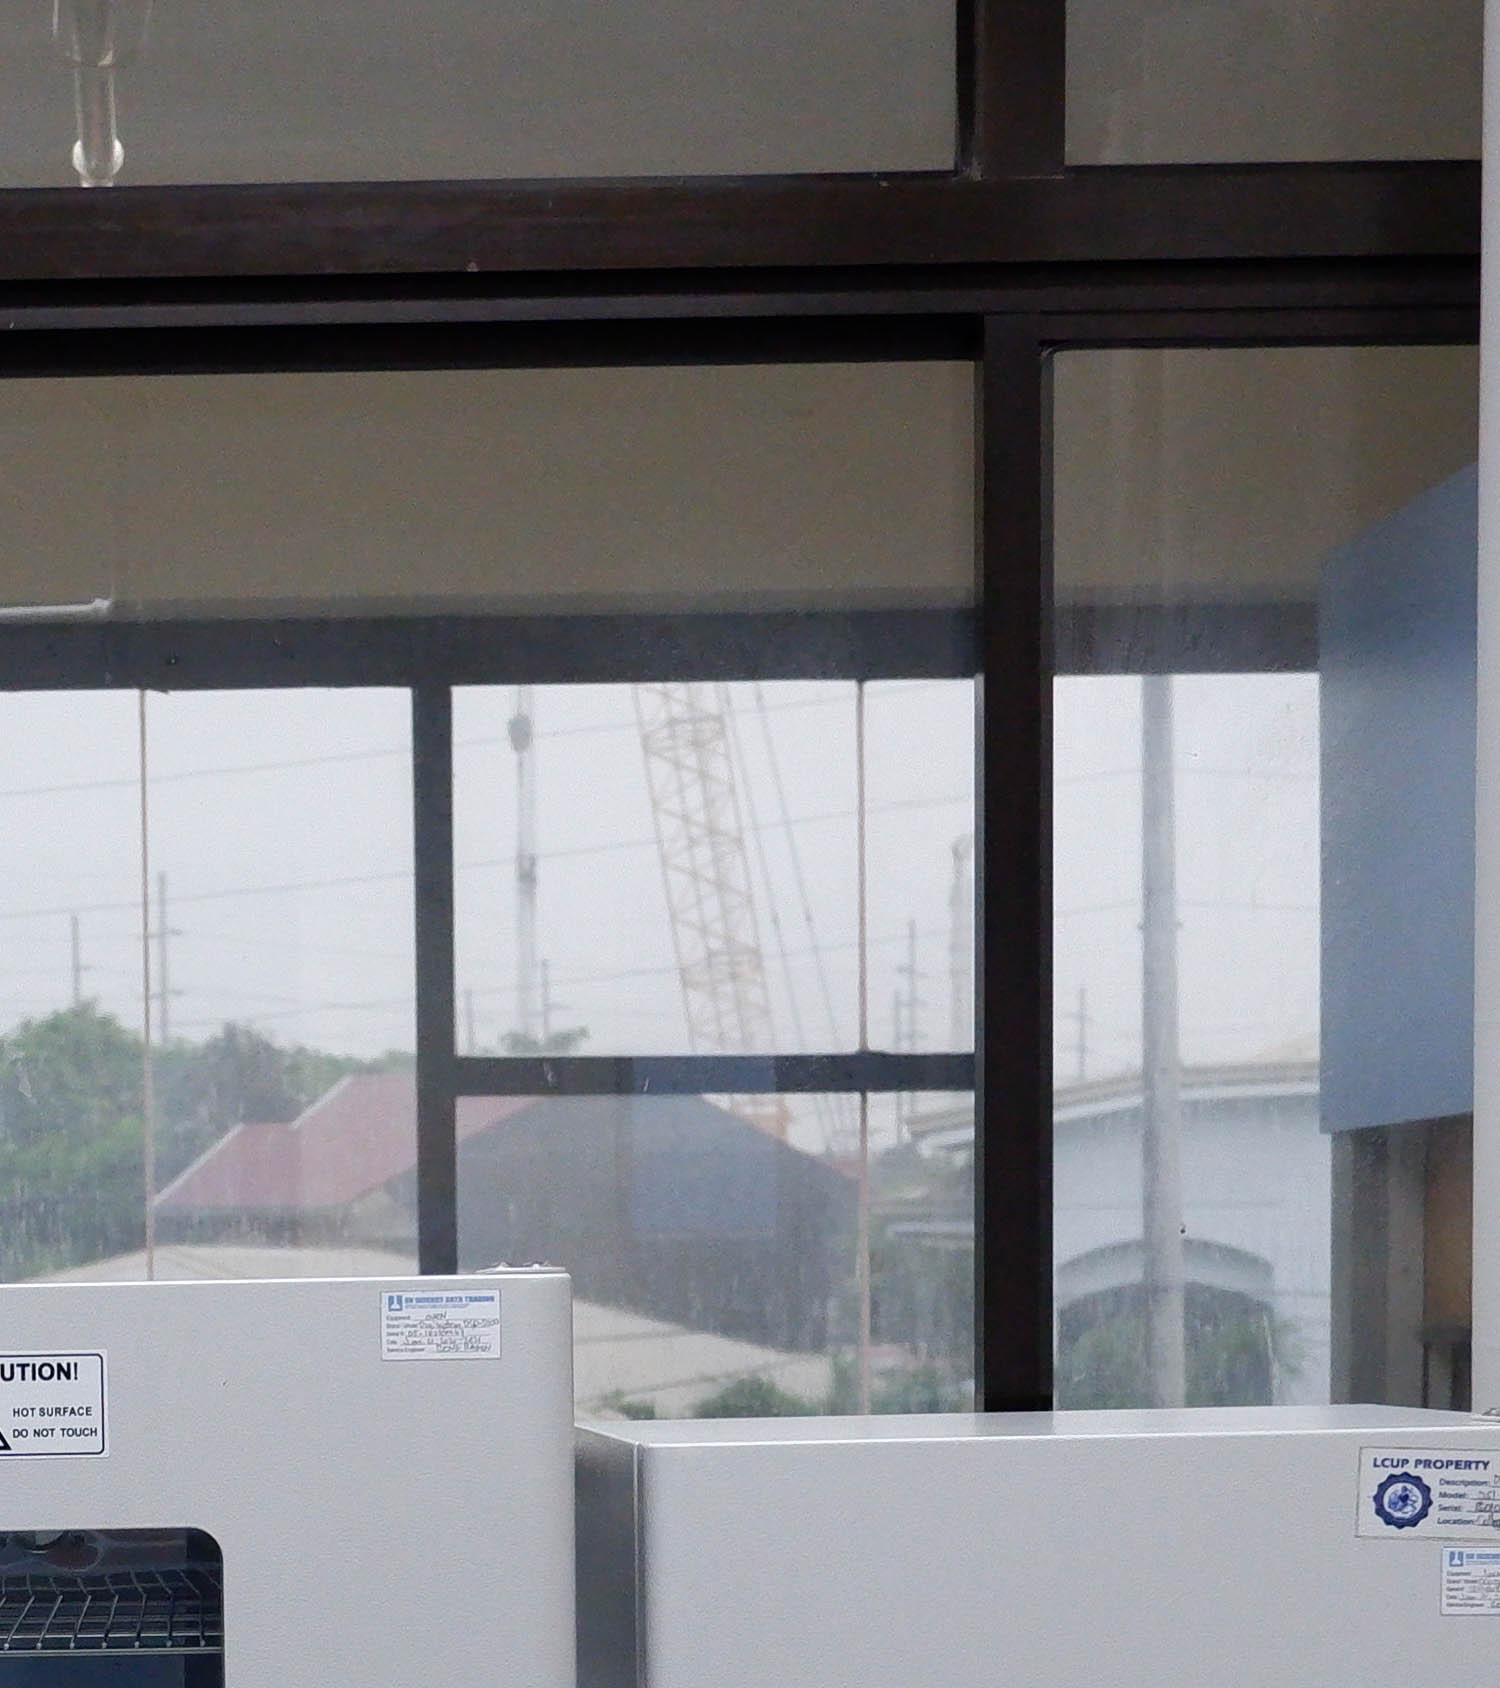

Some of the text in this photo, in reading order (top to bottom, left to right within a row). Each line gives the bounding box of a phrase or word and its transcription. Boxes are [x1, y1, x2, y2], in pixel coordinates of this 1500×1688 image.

[12, 1406, 93, 1418] HOT SURFACE
[12, 1427, 98, 1439] DO NOT TOUCH
[1373, 1457, 1410, 1468] LCUP
[1414, 1458, 1490, 1471] PROPERTY
